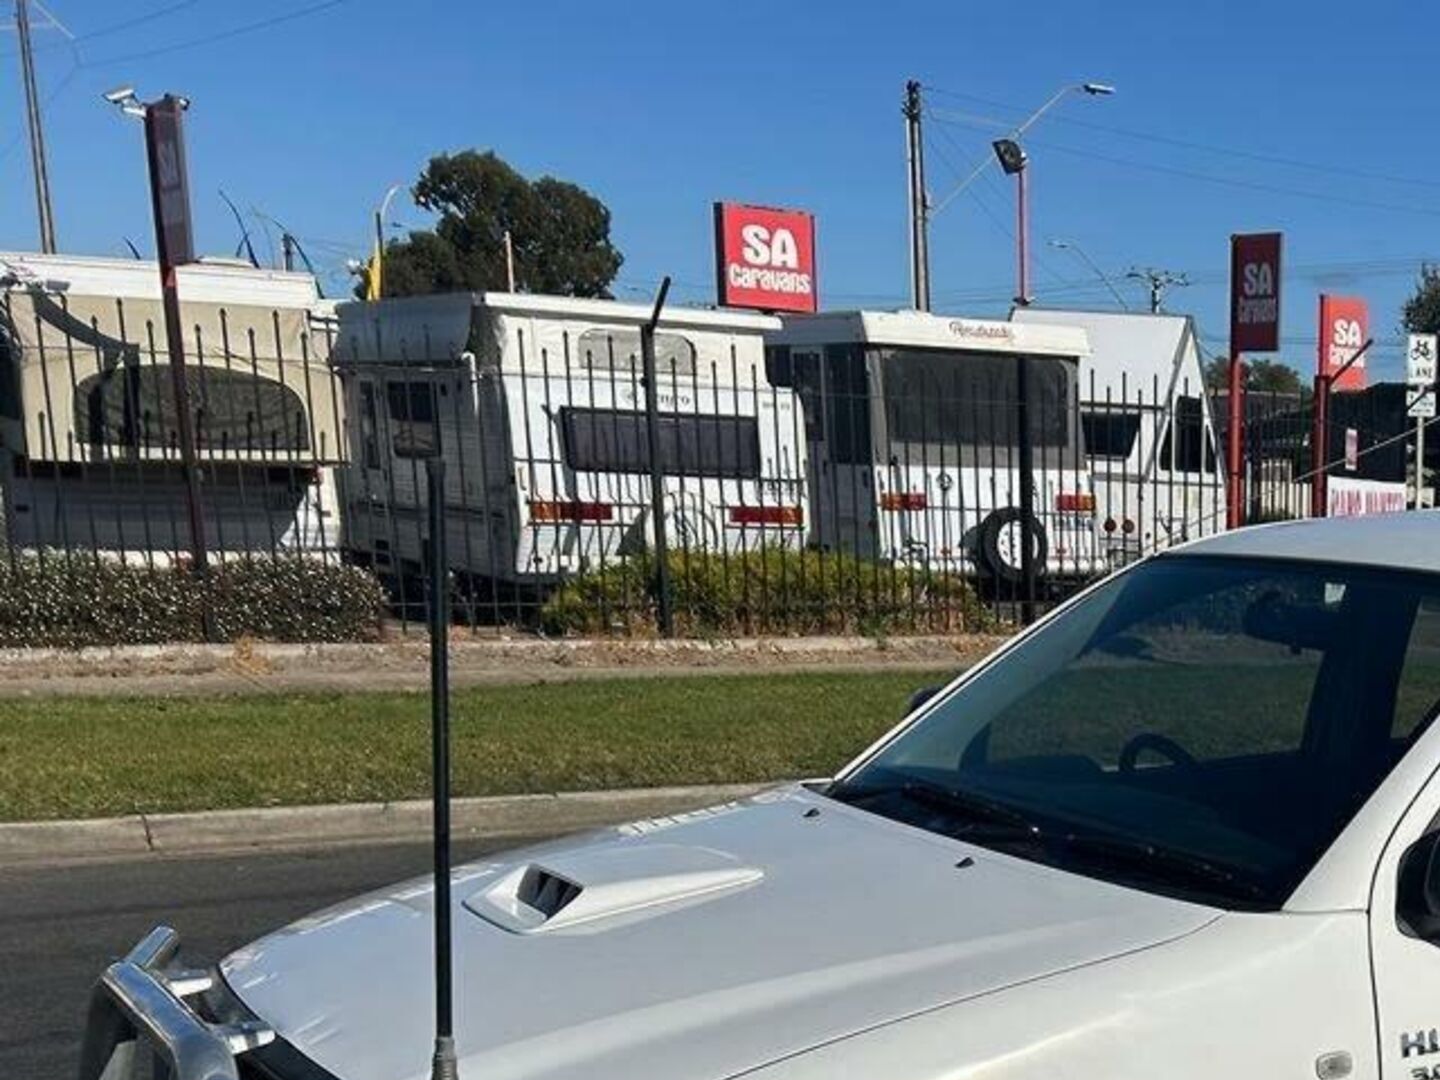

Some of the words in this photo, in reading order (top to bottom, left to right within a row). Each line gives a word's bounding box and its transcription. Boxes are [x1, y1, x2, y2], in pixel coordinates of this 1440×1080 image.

[742, 224, 799, 269] SA
[729, 262, 811, 294] Caravans
[1244, 263, 1272, 295] SA
[1333, 318, 1362, 347] SA
